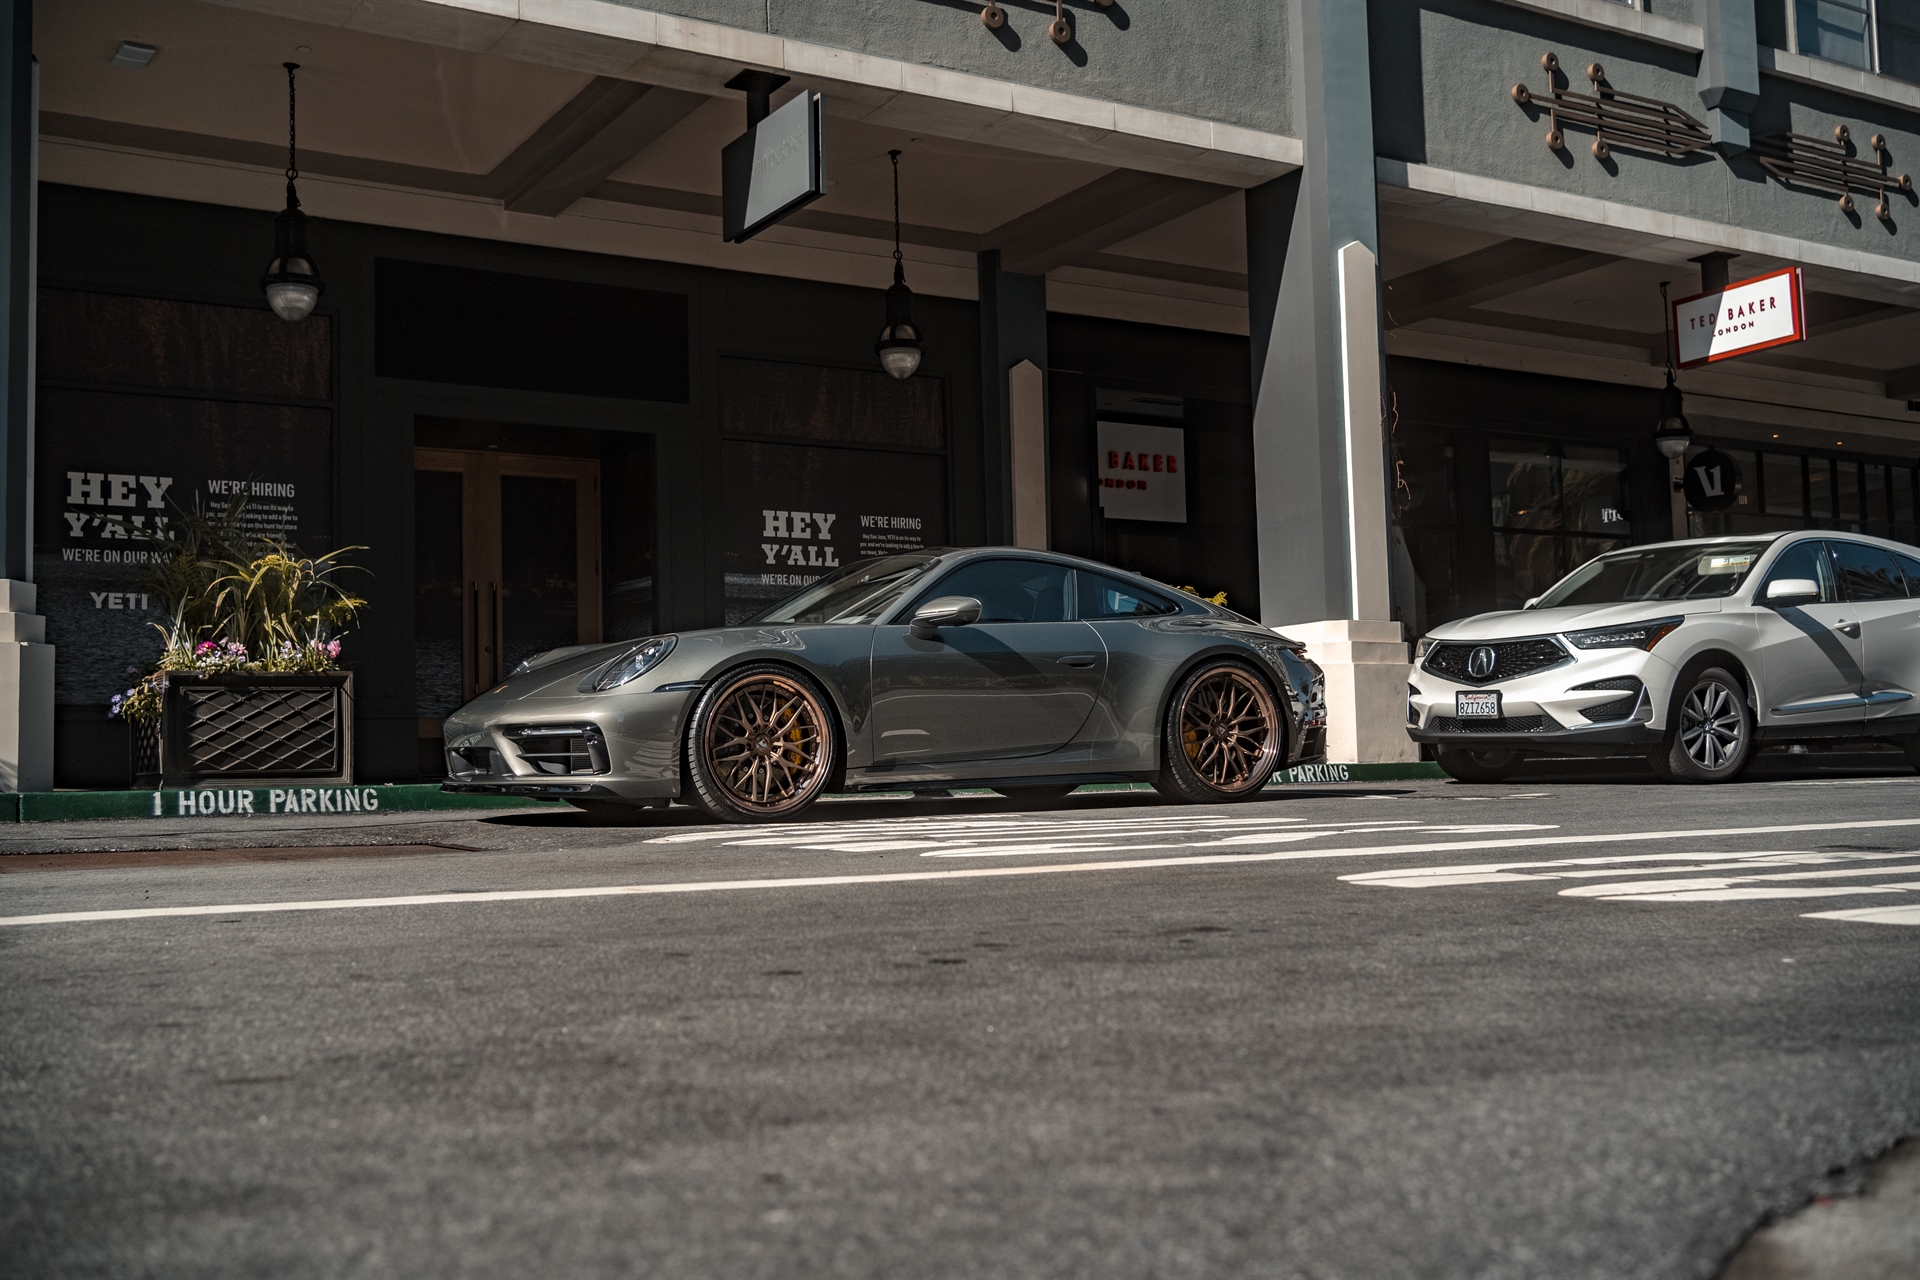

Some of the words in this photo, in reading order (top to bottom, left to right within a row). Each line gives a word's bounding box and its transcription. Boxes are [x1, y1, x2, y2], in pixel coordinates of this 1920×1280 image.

[1690, 313, 1716, 330] TED
[1728, 296, 1776, 320] BAKER
[1712, 321, 1754, 337] LONDON
[1108, 450, 1177, 474] BAKER
[67, 471, 172, 508] HEY
[252, 482, 295, 498] HIRING
[64, 512, 174, 540] Y'ALL
[762, 510, 836, 540] HEY
[860, 515, 889, 528] WE'RE
[891, 516, 922, 530] HIRING
[62, 548, 100, 562] WE'RE
[104, 549, 120, 562] ON
[124, 550, 148, 564] OUR
[151, 551, 172, 564] WA
[762, 544, 839, 567] Y'ALL
[761, 574, 788, 585] WE'RE
[790, 574, 801, 586] ON
[90, 592, 148, 610] YETI
[1460, 702, 1495, 714] 8ZIZ658
[1288, 764, 1349, 782] PARKING
[152, 792, 162, 816] 1
[178, 790, 254, 815] HOUR
[270, 788, 378, 813] PARKING
